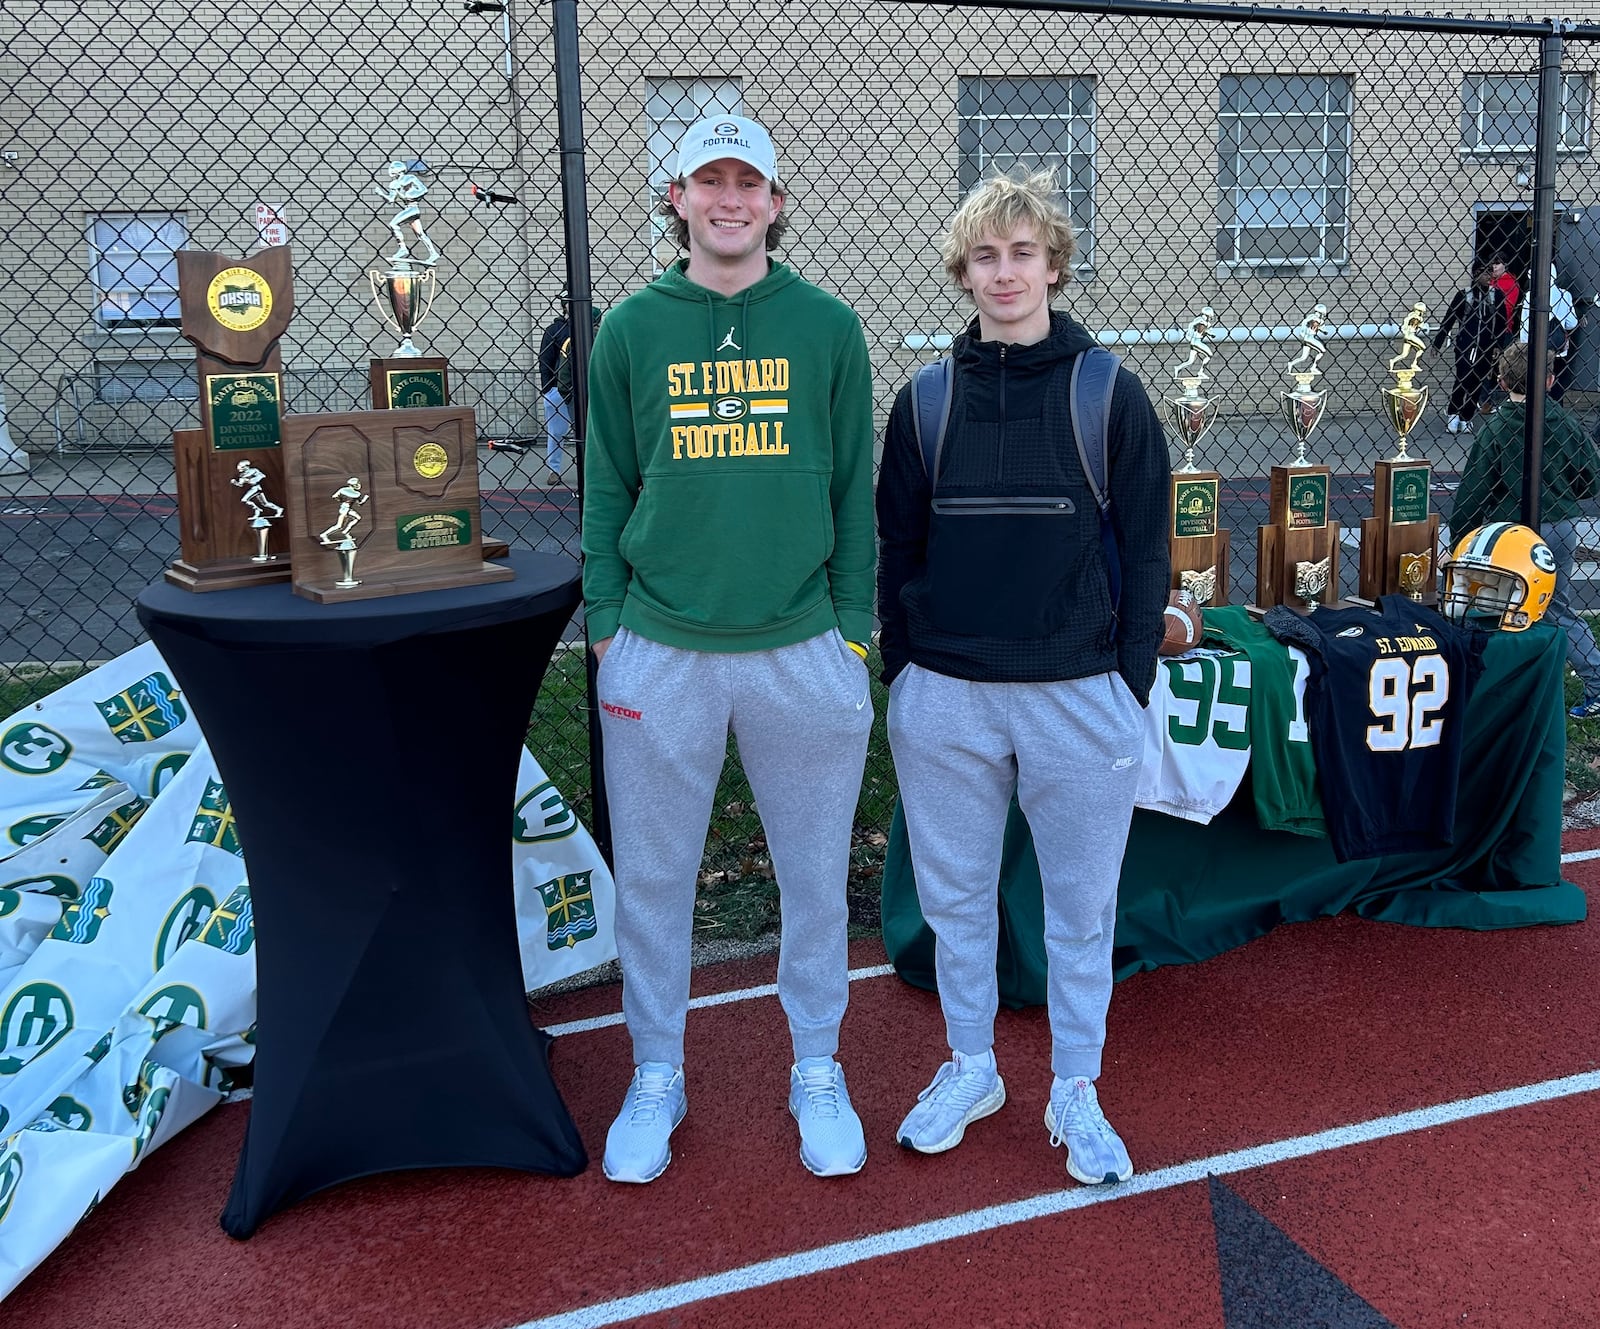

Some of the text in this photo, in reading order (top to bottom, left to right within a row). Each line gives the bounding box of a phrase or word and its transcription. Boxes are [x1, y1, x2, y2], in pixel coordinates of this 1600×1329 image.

[702, 137, 751, 149] FOOTBALL
[265, 236, 281, 244] LANE
[220, 292, 262, 306] OHSAA
[667, 358, 789, 396] ST. EDWARD
[213, 379, 277, 407] STATE CHAMPION
[392, 375, 443, 399] STATE CHAMPION
[229, 410, 263, 422] 2022
[219, 424, 268, 434] DIVISION
[220, 434, 273, 446] FOOTBALL
[670, 421, 790, 460] FOOTBALL
[1177, 485, 1214, 505] STATE CHAMPION
[1293, 511, 1318, 519] DIVISION
[410, 534, 460, 549] FOOTBALL
[1375, 636, 1437, 654] ST. EDWARD
[1163, 655, 1252, 751] 95
[1366, 653, 1450, 752] 92
